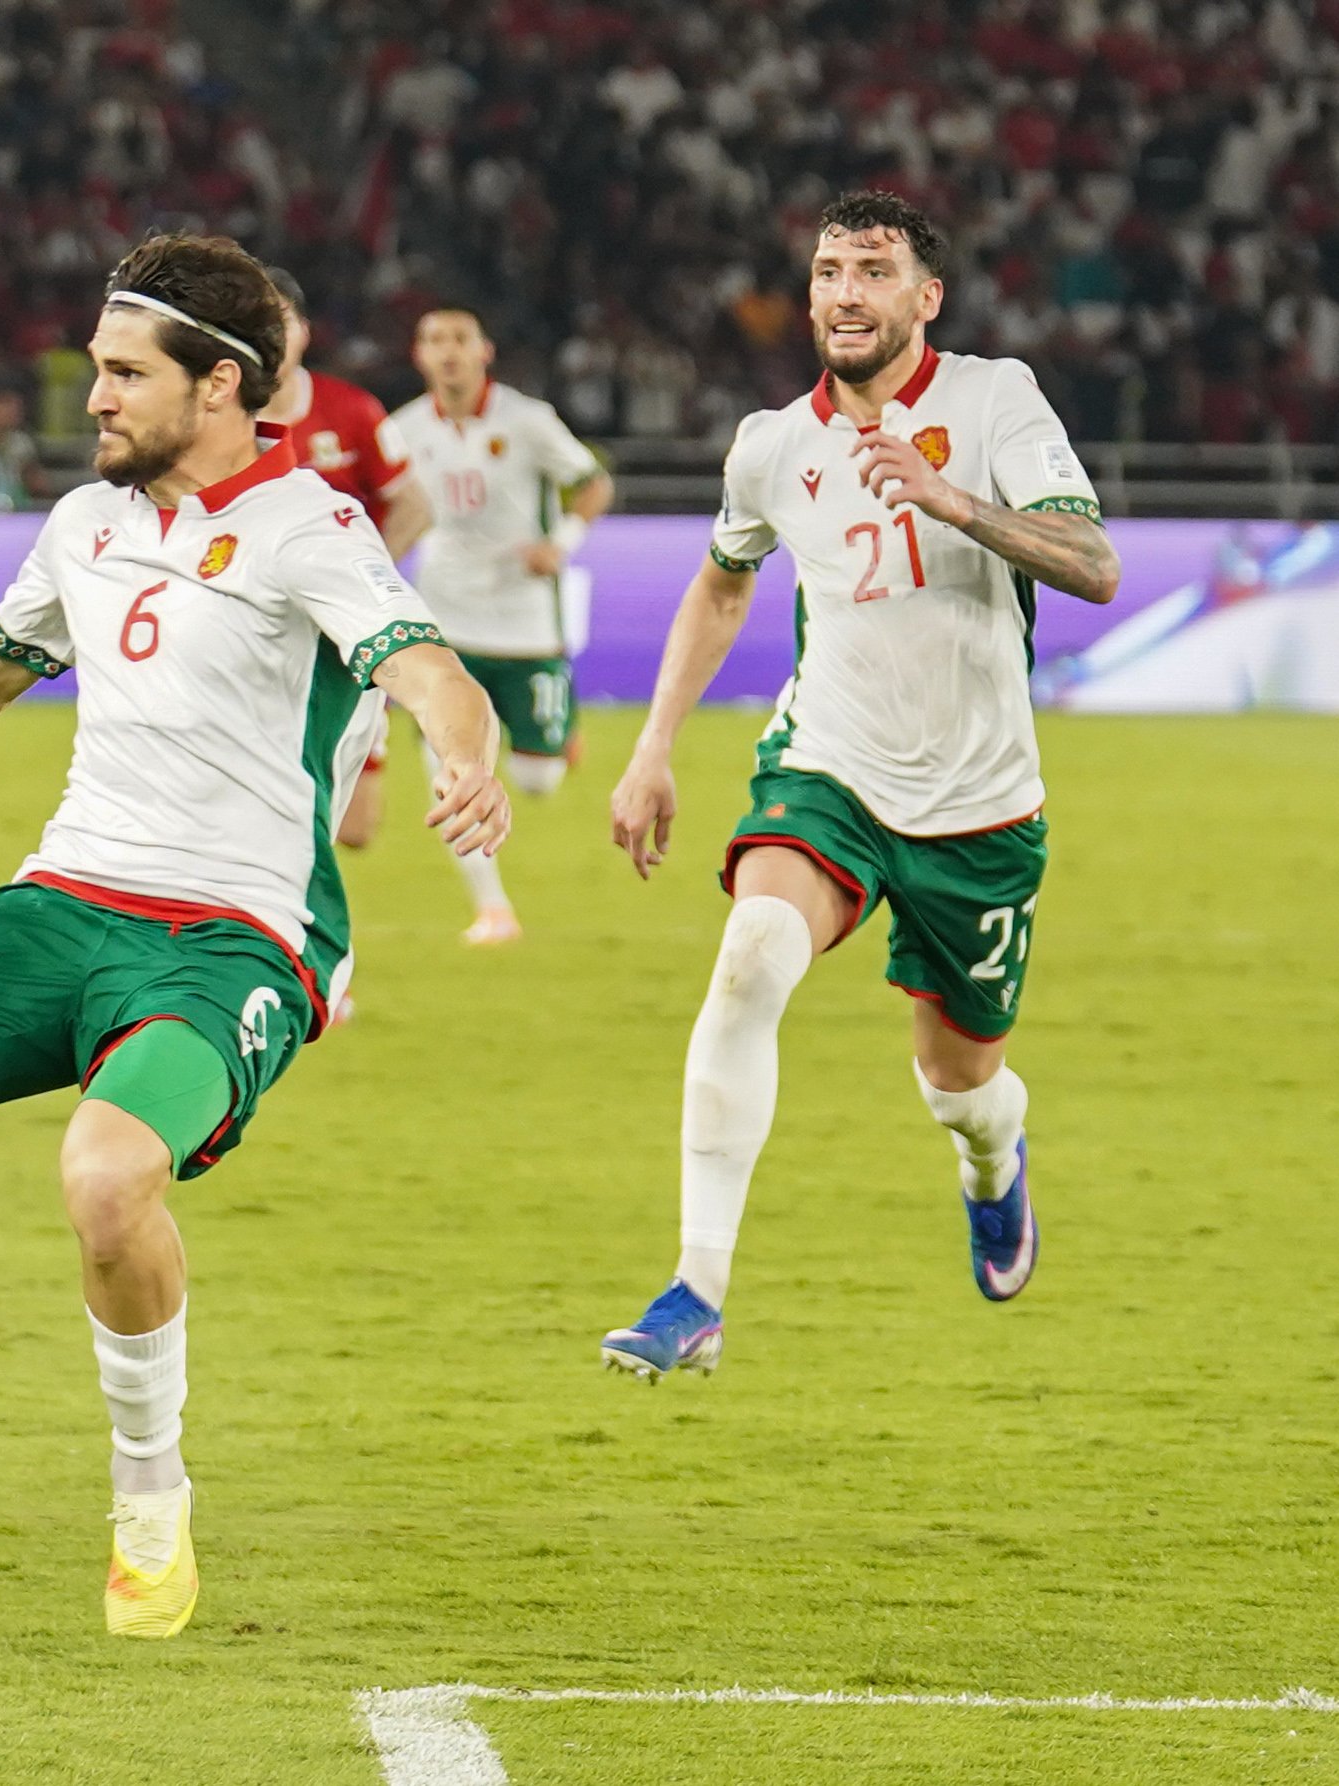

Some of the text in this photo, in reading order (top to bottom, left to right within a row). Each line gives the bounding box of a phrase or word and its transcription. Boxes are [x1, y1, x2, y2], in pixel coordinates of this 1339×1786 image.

[442, 470, 487, 511] 10
[845, 510, 926, 603] 21
[119, 580, 168, 662] 6
